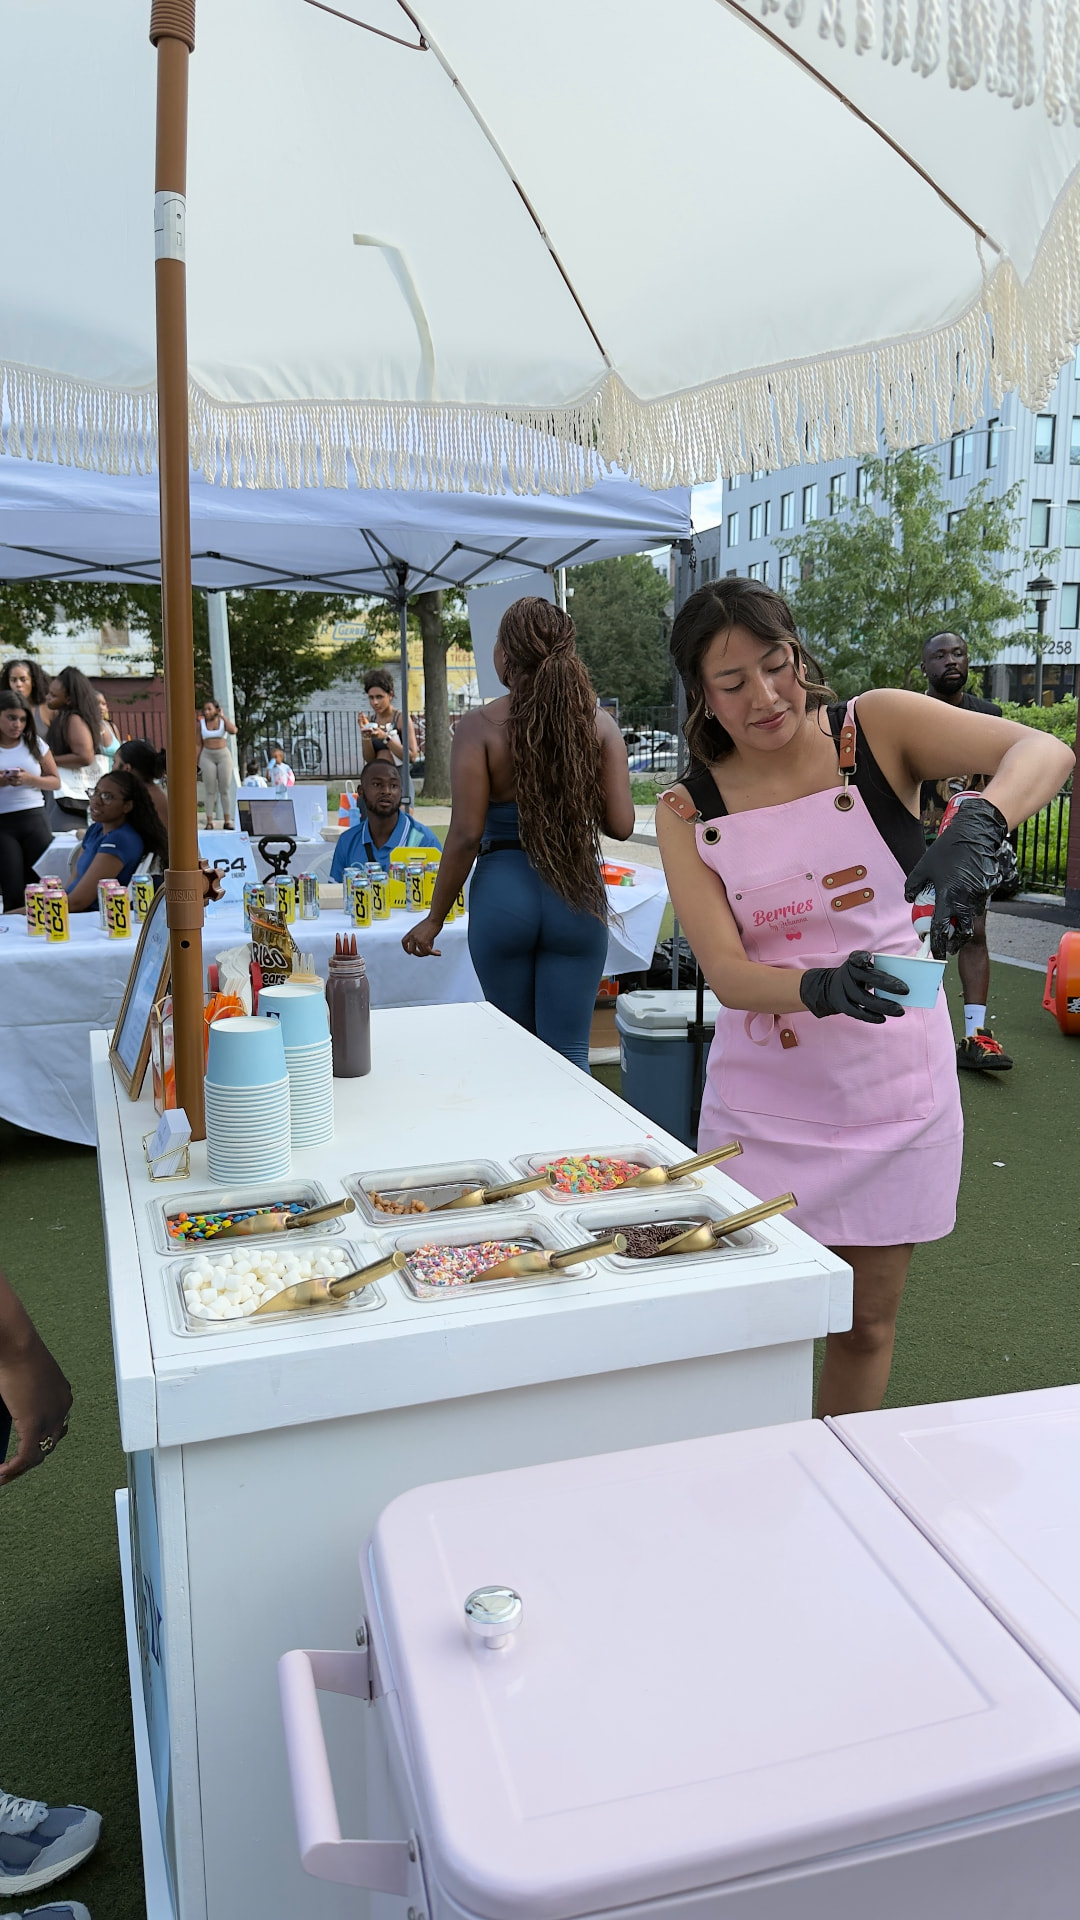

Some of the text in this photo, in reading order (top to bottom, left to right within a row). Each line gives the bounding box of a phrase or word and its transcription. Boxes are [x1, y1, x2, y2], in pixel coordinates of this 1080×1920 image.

[212, 857, 247, 873] C4
[137, 886, 147, 913] C4
[372, 883, 382, 911] C4
[412, 877, 421, 903] C4
[52, 902, 64, 932] C4
[114, 899, 126, 929] C4
[356, 890, 366, 919] C4
[753, 899, 813, 927] Berries
[251, 942, 288, 968] RIBO
[262, 973, 287, 984] ears
